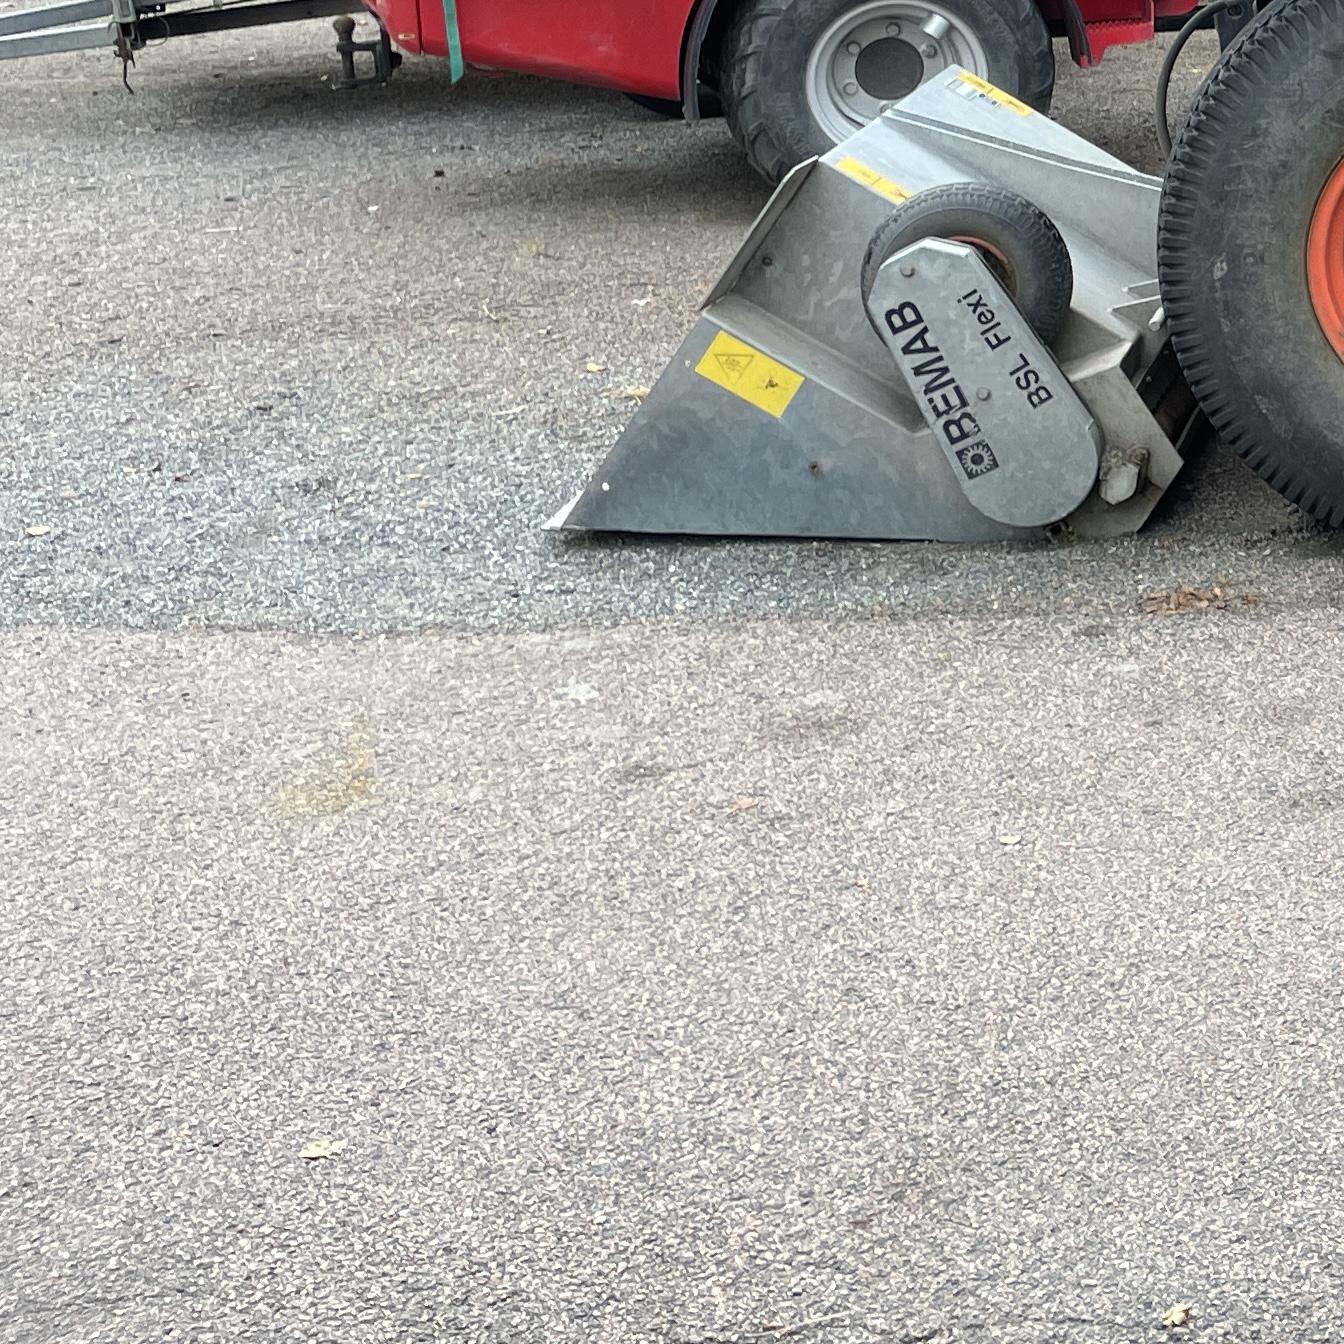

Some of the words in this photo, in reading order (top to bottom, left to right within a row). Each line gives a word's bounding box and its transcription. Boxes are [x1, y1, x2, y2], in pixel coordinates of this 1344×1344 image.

[957, 288, 1012, 351] Flexi
[884, 300, 982, 446] BEMAB
[1008, 352, 1055, 410] BSL
